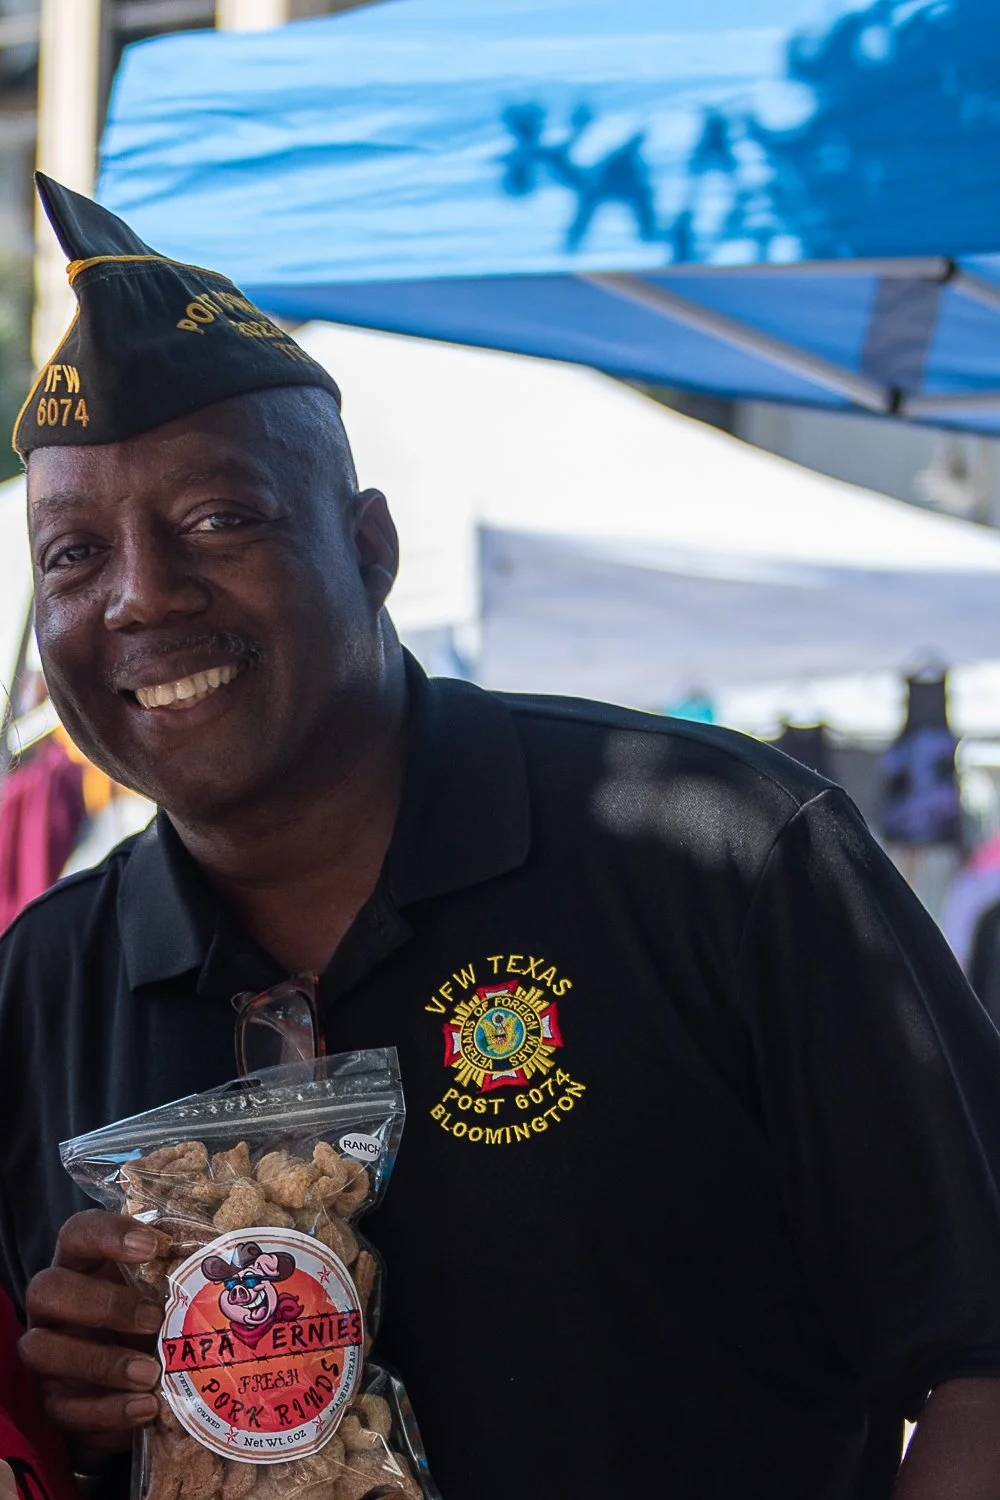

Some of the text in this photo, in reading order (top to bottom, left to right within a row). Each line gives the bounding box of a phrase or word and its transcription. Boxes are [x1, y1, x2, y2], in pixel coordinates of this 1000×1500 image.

[37, 397, 90, 428] 6074
[424, 954, 573, 1014] VFW TEXAS
[461, 997, 541, 1070] VETERANS OF FOREIGN WARS
[430, 1081, 586, 1145] BLOOMINGTON
[442, 1068, 570, 1115] POST 6074
[343, 1138, 381, 1155] RANCH
[166, 1316, 362, 1366] PAPA ERNIES
[201, 1358, 340, 1429] PORK RINDS
[238, 1368, 300, 1395] FRESH
[329, 1351, 356, 1415] MADE IN TEXAS
[196, 1407, 221, 1430] OWNED
[243, 1437, 264, 1448] Net
[265, 1437, 286, 1447] Wt.
